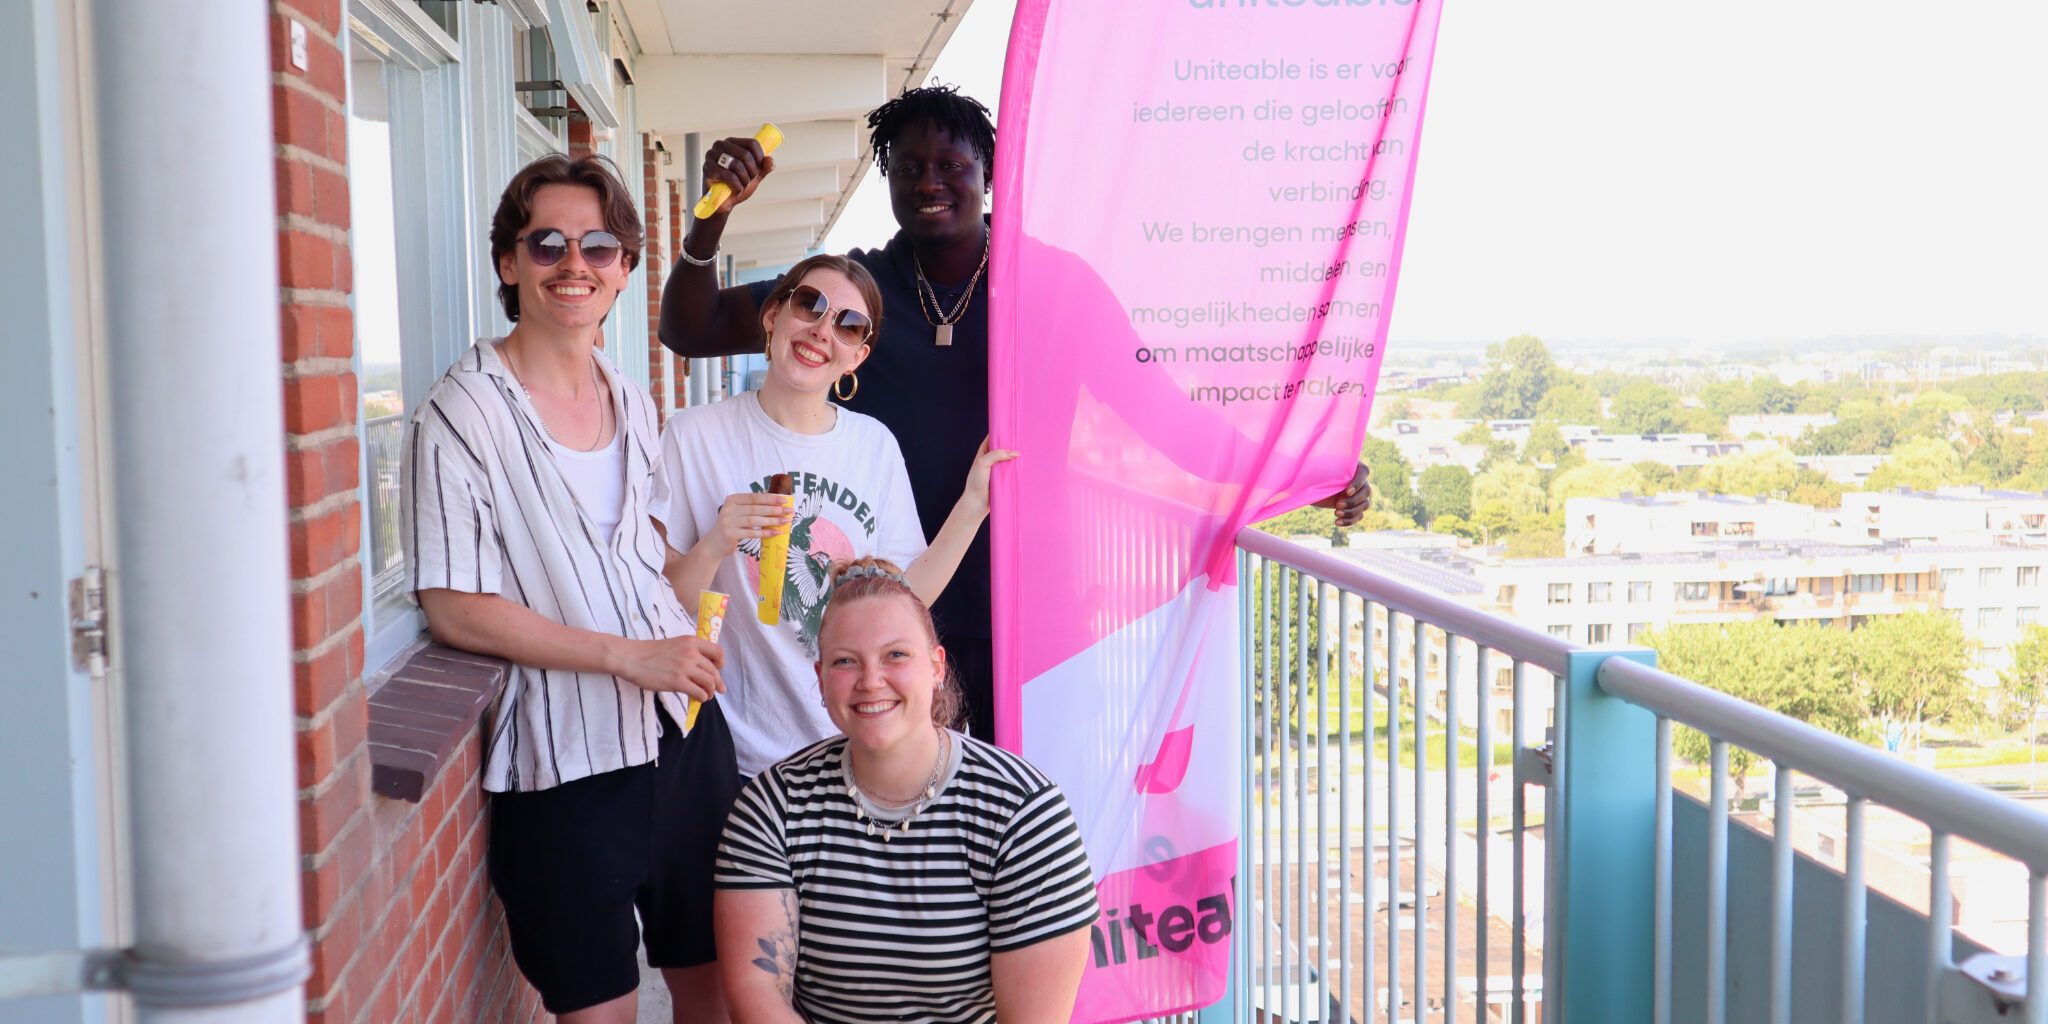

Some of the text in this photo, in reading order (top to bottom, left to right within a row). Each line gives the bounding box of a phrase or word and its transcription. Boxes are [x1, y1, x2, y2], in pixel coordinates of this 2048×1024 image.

[1173, 56, 1414, 82] Uniteable is er voor
[1132, 99, 1246, 124] iedereen
[1252, 98, 1294, 122] die
[1300, 96, 1389, 127] gelooft
[1241, 138, 1277, 162] de
[1283, 138, 1369, 162] kracht
[1267, 178, 1393, 202] verbinding.
[1141, 218, 1392, 249] We brengen mensen,
[1260, 258, 1388, 283] middelen en
[1130, 299, 1382, 329] mogelijkheden samen
[1135, 334, 1375, 364] om maatschappelijke
[1189, 379, 1281, 407] impact
[1282, 381, 1295, 400] te
[1090, 875, 1236, 969] nitea
